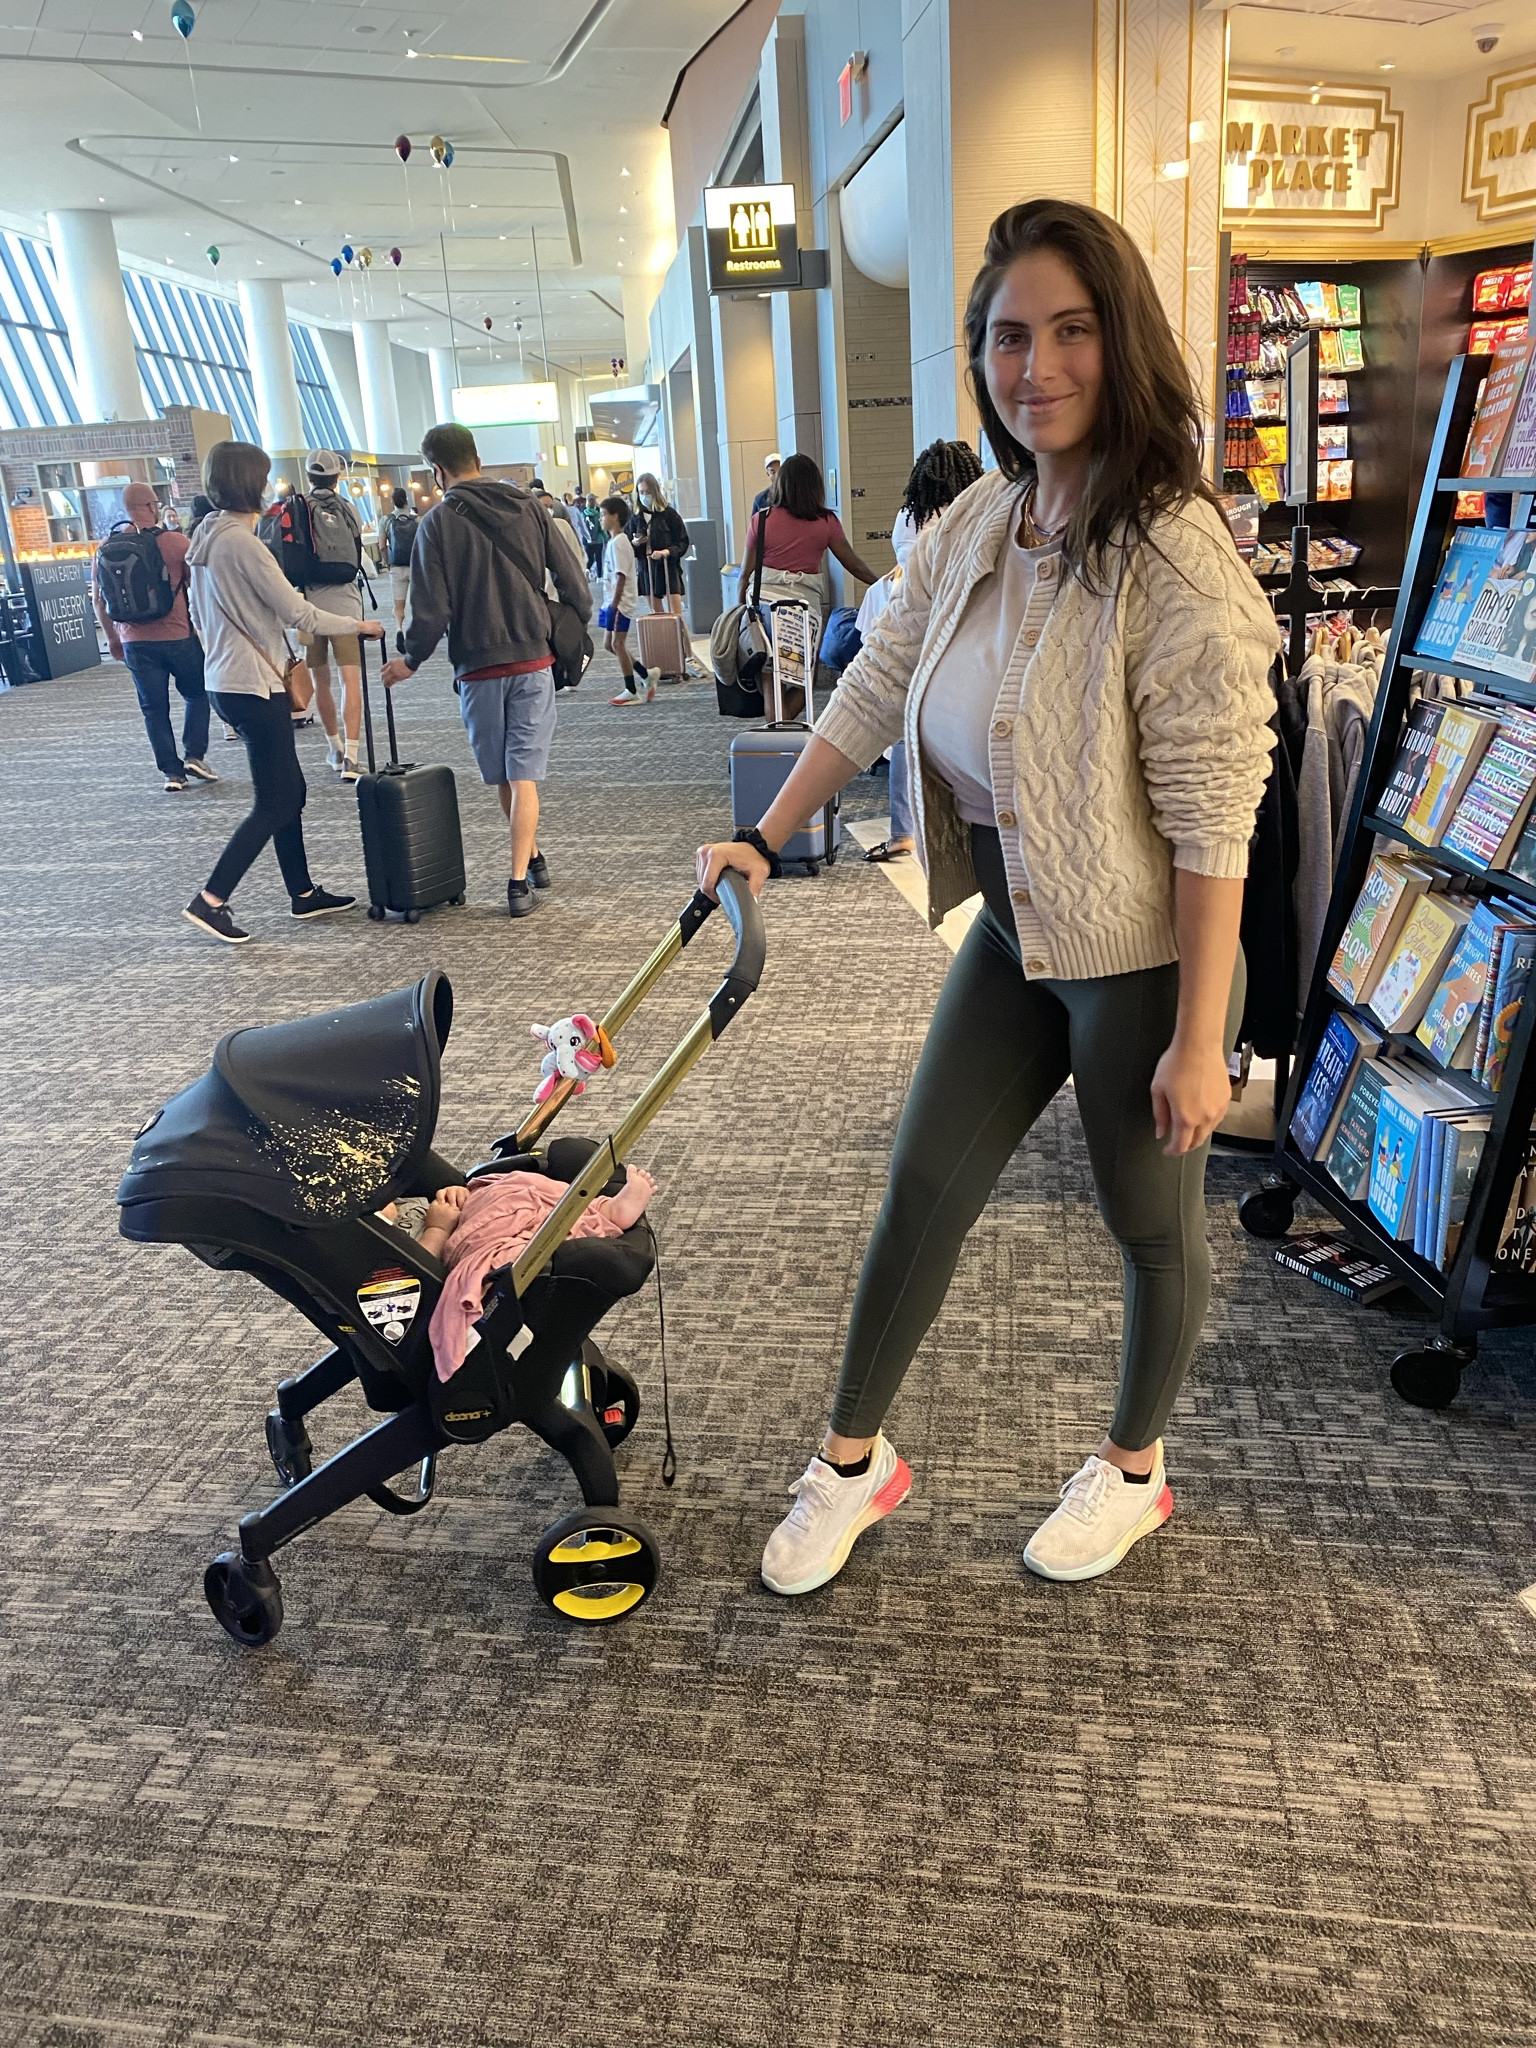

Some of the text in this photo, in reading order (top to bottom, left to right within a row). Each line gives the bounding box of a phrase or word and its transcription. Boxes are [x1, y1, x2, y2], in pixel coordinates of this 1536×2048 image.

[1226, 121, 1375, 158] MARKET
[1248, 158, 1353, 192] PLACE
[726, 259, 782, 272] Restrooms
[1478, 396, 1513, 420] VACATION
[1226, 502, 1252, 516] ROUGH
[1454, 531, 1502, 549] EMILY HENRY
[34, 564, 80, 585] ITALIAN EATERY
[40, 594, 86, 621] MULBERRY
[1433, 599, 1465, 624] BOOK
[1472, 588, 1517, 625] MAYB
[53, 618, 85, 644] STREET
[1420, 619, 1460, 647] LOVERS
[1424, 713, 1436, 729] THE
[1441, 720, 1471, 749] BEACH
[1507, 716, 1534, 744] The
[1402, 728, 1436, 757] TURNOU
[1435, 742, 1458, 770] READ
[1489, 738, 1532, 776] Candy
[1393, 771, 1417, 792] MEGAN
[1475, 760, 1519, 797] House
[1378, 787, 1412, 818] ABBOTT
[1456, 795, 1510, 834] Jennifer
[1449, 820, 1485, 856] Egan
[1365, 871, 1395, 908] HOPE
[1467, 920, 1492, 948] REMARKAB
[1340, 928, 1371, 969] GLORY
[1463, 941, 1484, 963] BRIGHT
[1453, 954, 1481, 985] CREATURES
[1486, 952, 1497, 980] Candy
[1432, 1009, 1452, 1034] SHELBY
[1423, 1021, 1447, 1052] VAN PELT
[1311, 1067, 1330, 1102] LESS
[1360, 1085, 1380, 1108] FOREVE
[1350, 1117, 1368, 1140] TAYLOR
[1382, 1094, 1418, 1135] EMILY HENRY
[1340, 1123, 1358, 1145] JENKINS
[1358, 1141, 1370, 1158] REID
[1376, 1162, 1399, 1201] BOOK
[1370, 1177, 1398, 1224] LOVERS
[1299, 1242, 1351, 1264] TURNOUT
[1274, 1251, 1354, 1299] THE TURNOUT MEGAN ABBOTT
[1338, 1260, 1372, 1275] MEGAN
[1348, 1264, 1391, 1288] ABBOTT
